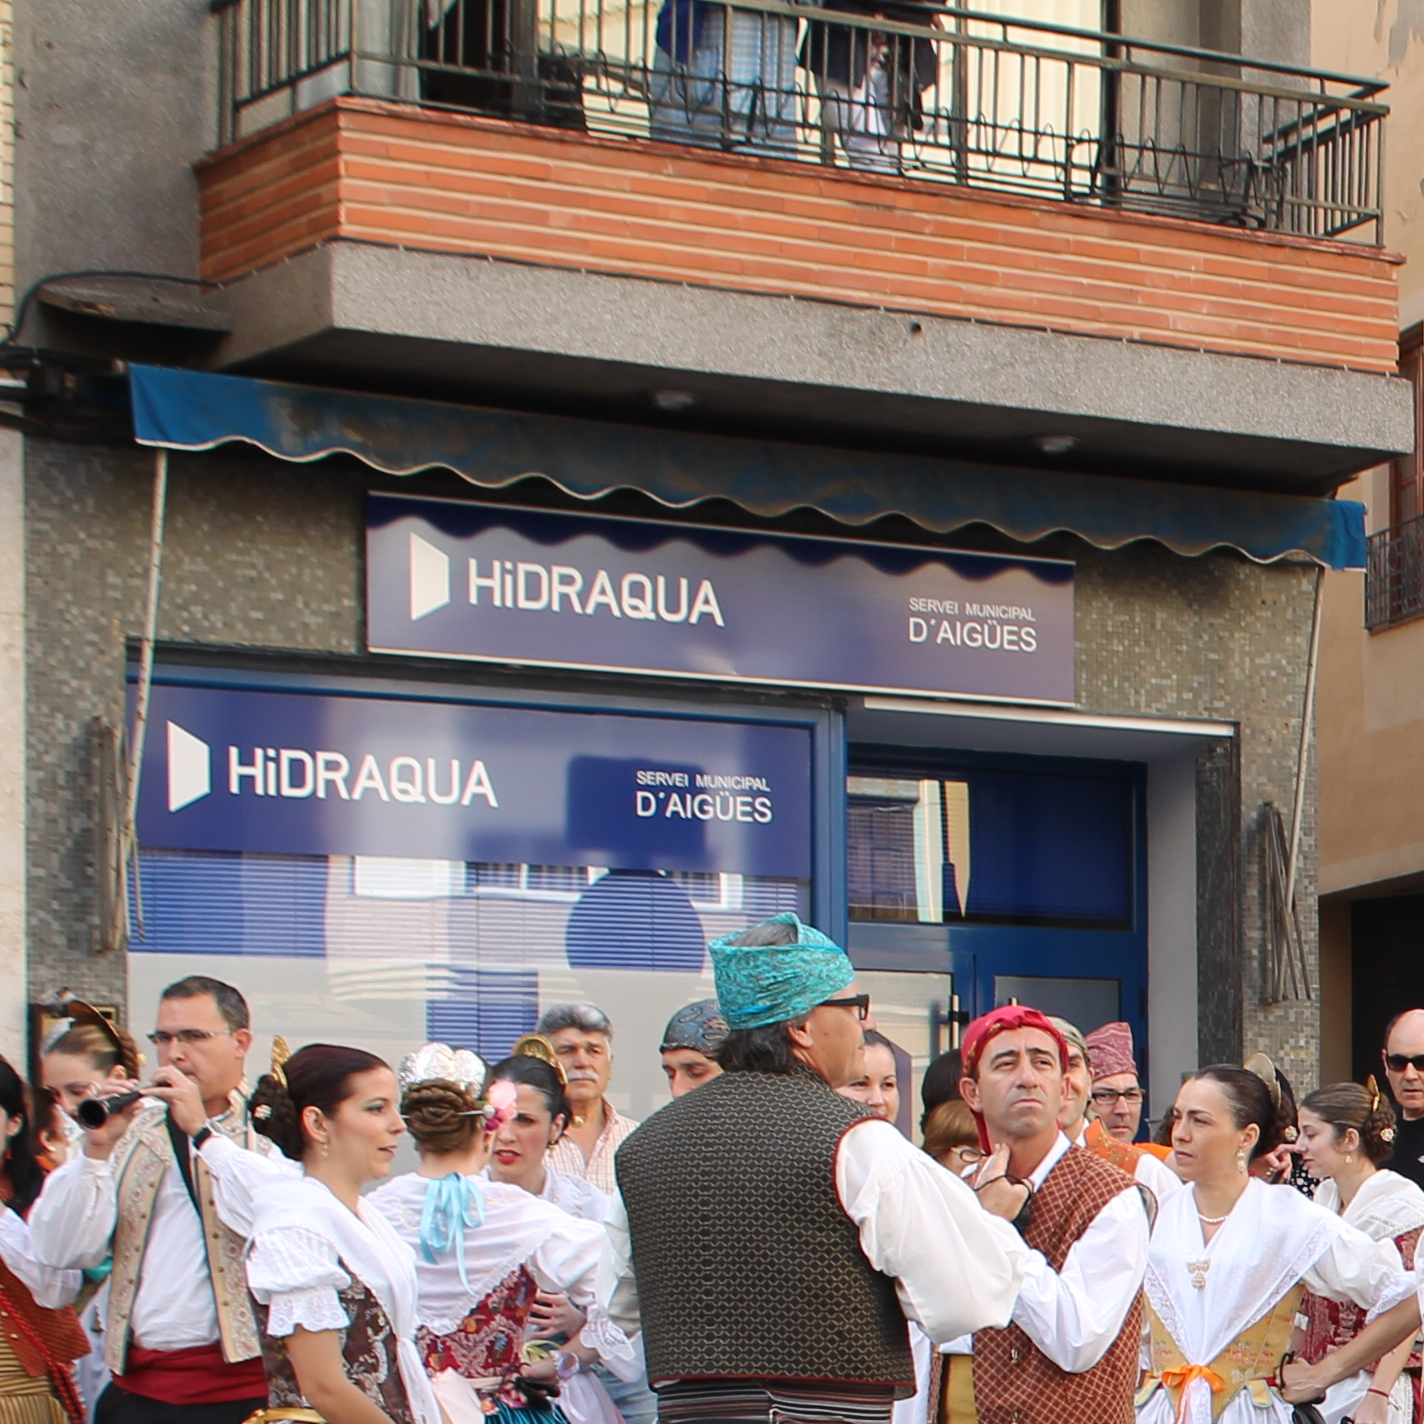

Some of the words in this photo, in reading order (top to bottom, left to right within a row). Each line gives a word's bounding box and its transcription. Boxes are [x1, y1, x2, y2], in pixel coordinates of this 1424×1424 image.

[468, 557, 726, 627] HiDRAQUA
[909, 597, 959, 615] SERVEI
[965, 602, 1036, 622] MUNICIPAL
[228, 745, 498, 807] HiDRAQUA
[636, 770, 688, 787] SERVEI
[696, 774, 771, 791] MUNICIPAL
